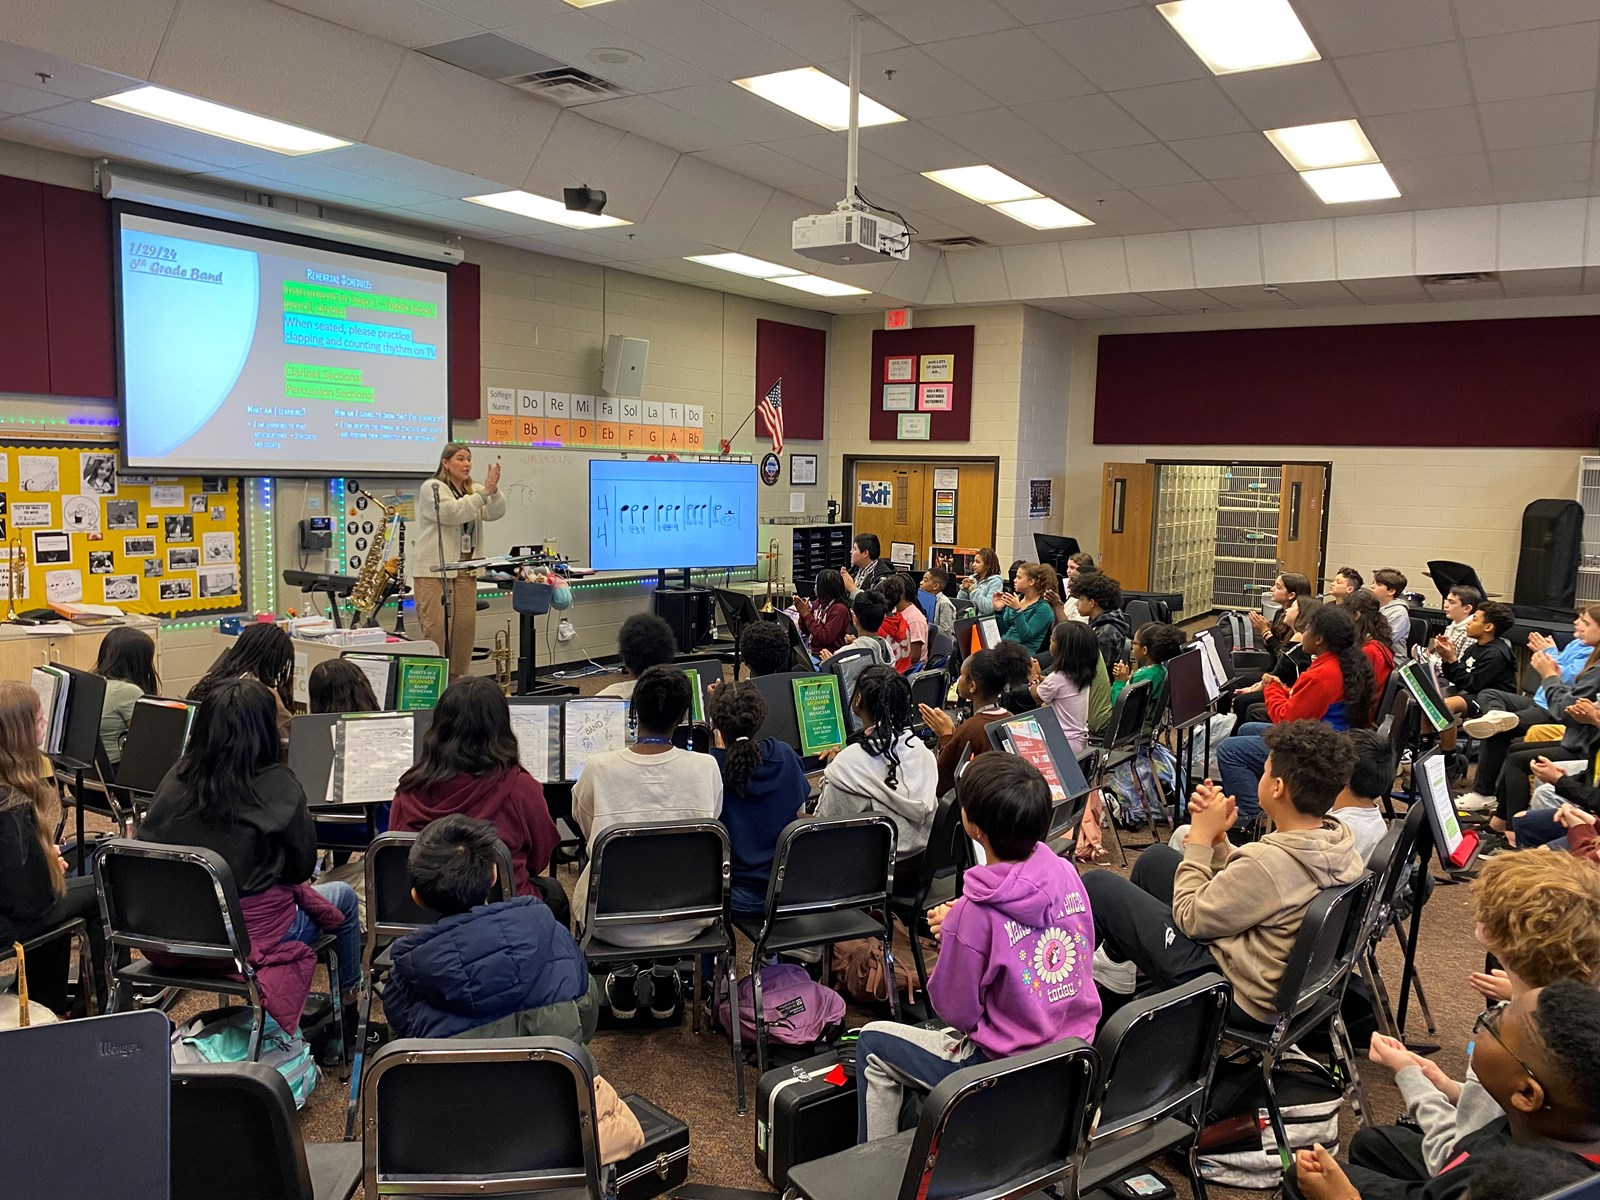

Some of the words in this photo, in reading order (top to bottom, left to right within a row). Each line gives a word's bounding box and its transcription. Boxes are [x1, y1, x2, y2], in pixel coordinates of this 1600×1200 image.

[129, 242, 177, 260] 1/29/24
[190, 267, 223, 282] Band
[285, 318, 312, 330] When
[315, 322, 346, 336] seated,
[349, 325, 376, 338] please
[378, 330, 410, 342] practice
[285, 332, 324, 346] clapping
[326, 336, 342, 346] and
[344, 338, 382, 352] counting
[383, 342, 412, 356] rhythm
[414, 348, 424, 356] on
[426, 346, 436, 358] TV
[286, 366, 321, 379] Clarinet
[286, 384, 334, 398] Percussion
[490, 390, 512, 400] Solfege
[523, 396, 538, 408] Do
[551, 398, 564, 410] Re
[576, 400, 589, 412] Mi
[602, 403, 612, 415] Fa
[624, 404, 637, 416] Sol
[648, 407, 658, 418] La
[670, 408, 677, 419] Ti
[689, 410, 699, 421] Do
[493, 403, 510, 411] Name
[491, 418, 512, 426] Concert
[524, 423, 538, 435] Bb
[554, 425, 561, 436] C
[580, 426, 586, 437] D
[602, 428, 614, 440] Eb
[628, 430, 634, 440] F
[650, 431, 656, 442] G
[671, 433, 677, 443] A
[689, 433, 699, 444] Bb
[862, 482, 890, 505] Exit
[584, 721, 603, 735] BAND
[97, 1042, 140, 1057] Wenger
